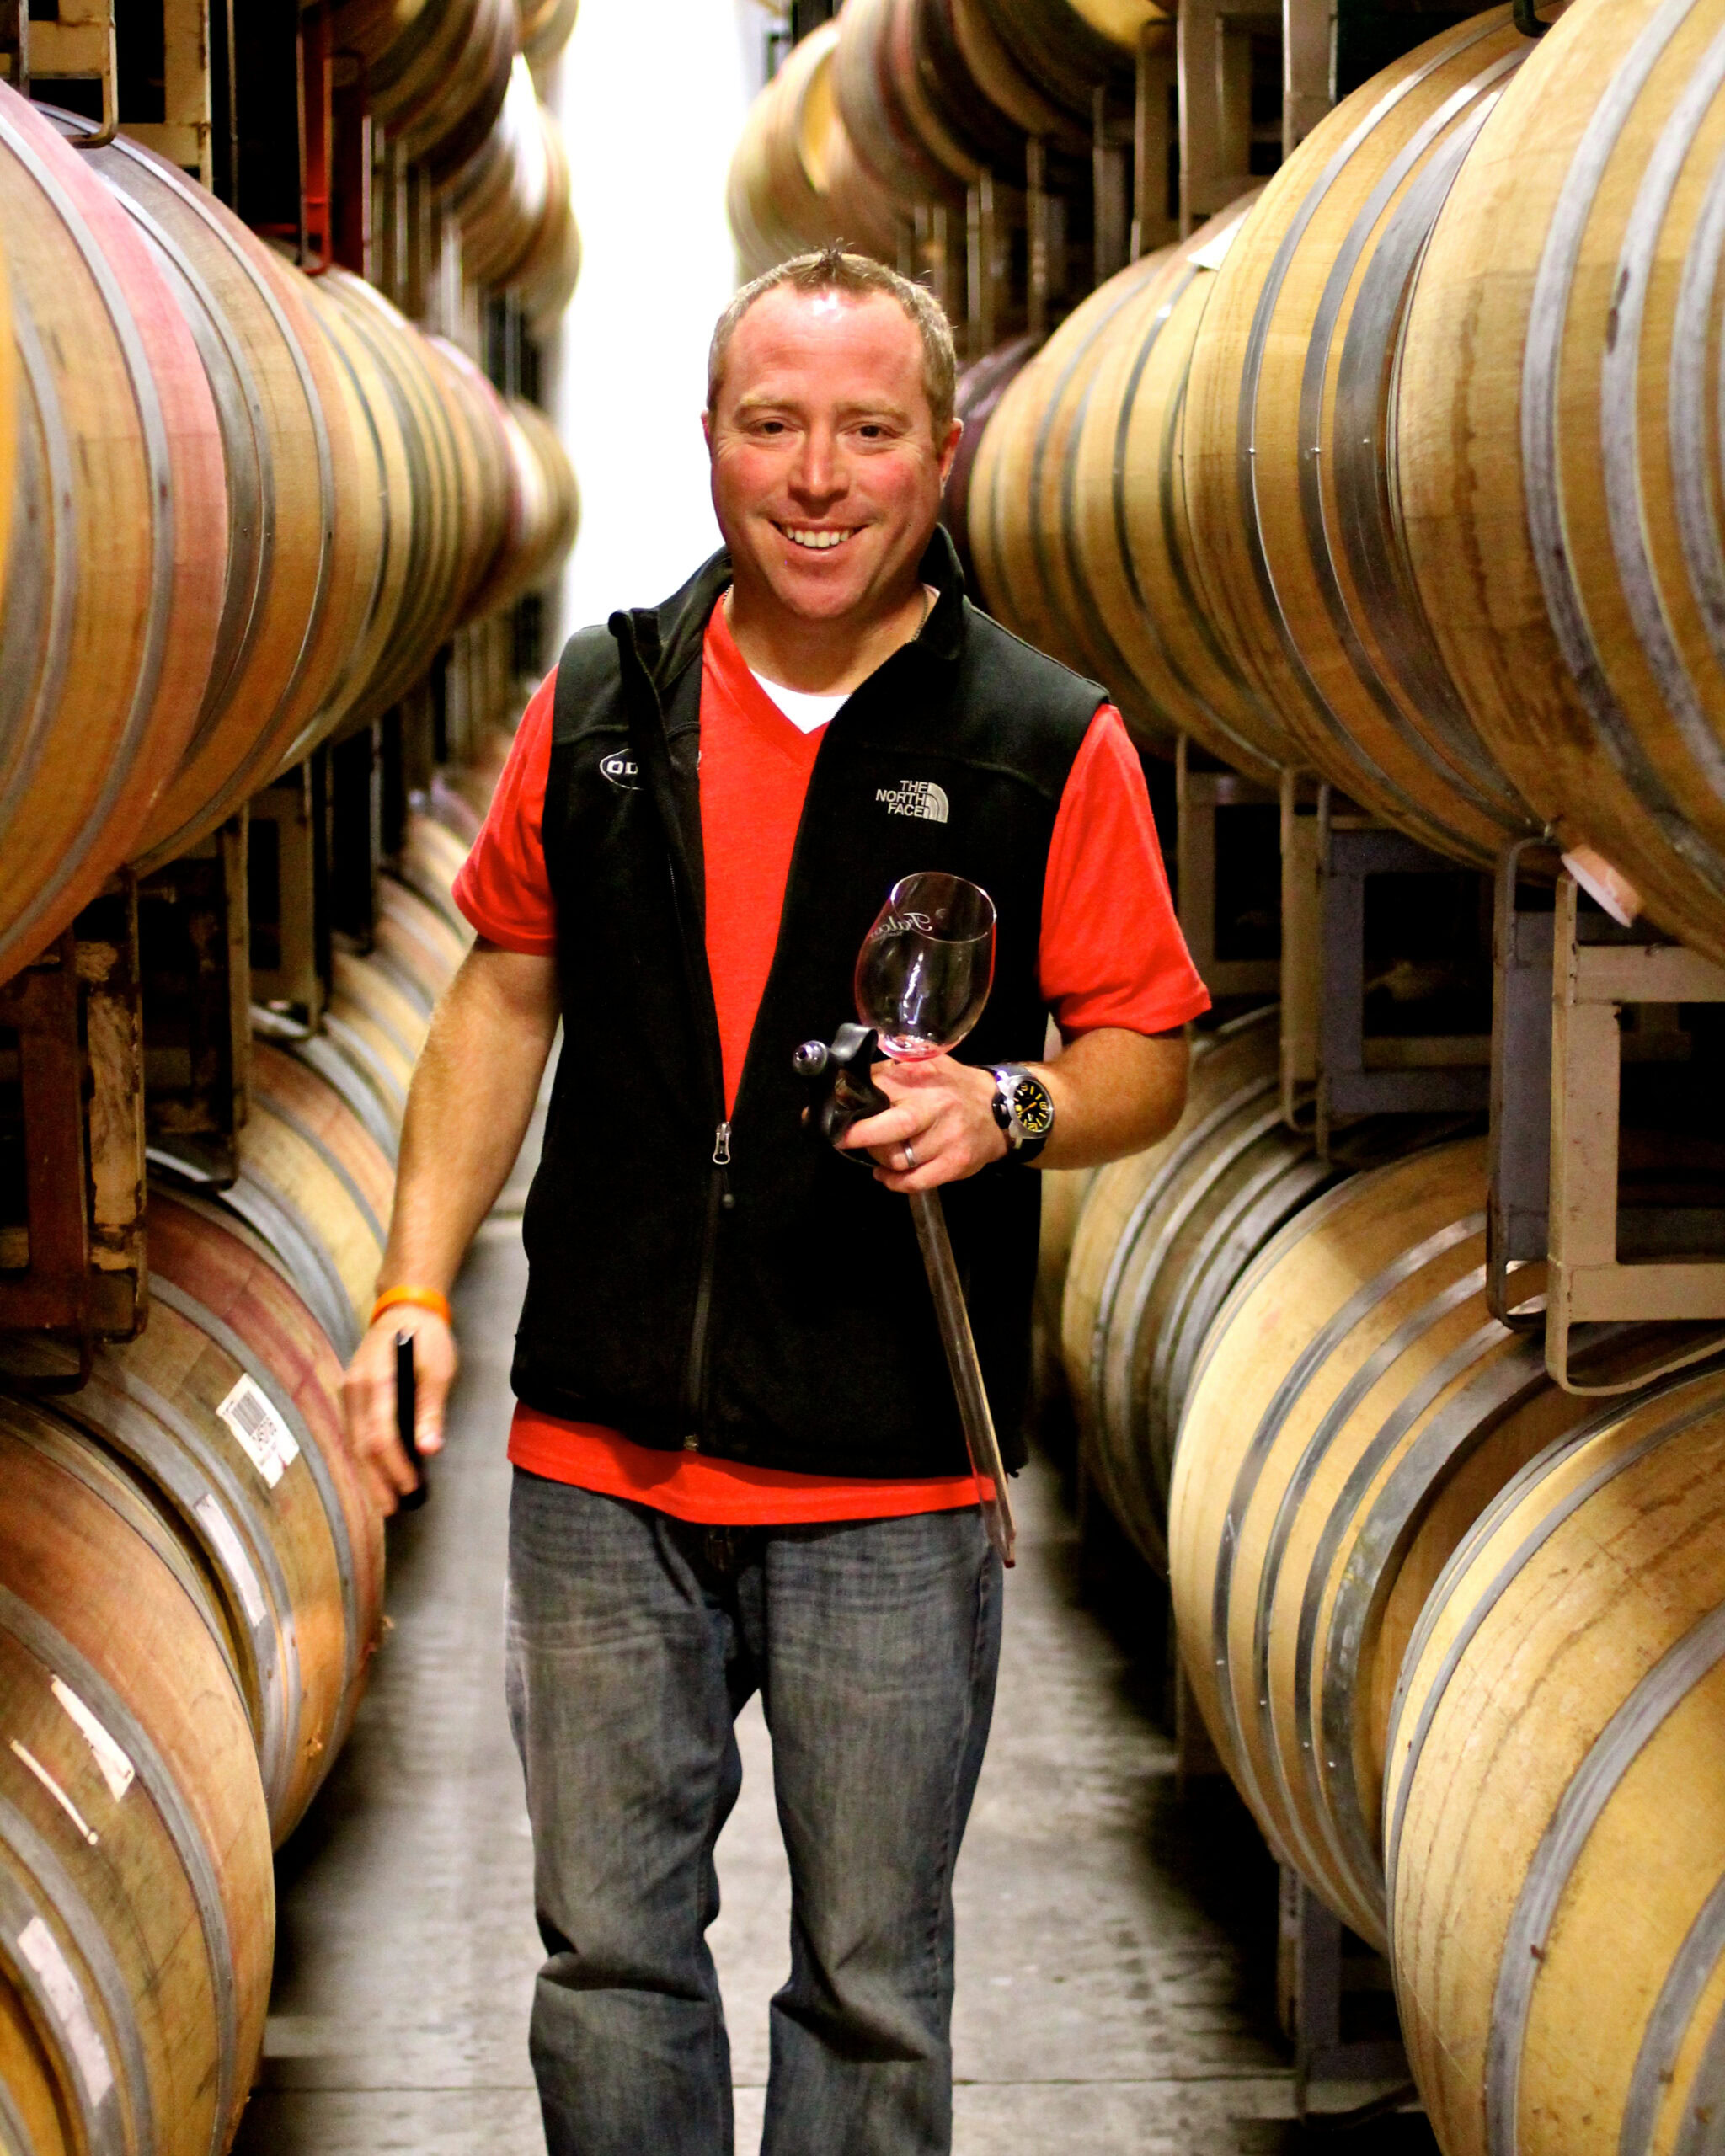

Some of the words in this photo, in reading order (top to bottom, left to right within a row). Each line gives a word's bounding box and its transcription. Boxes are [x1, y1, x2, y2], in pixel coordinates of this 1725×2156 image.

[900, 780, 928, 793] THE
[875, 788, 926, 806] NORTH
[887, 803, 924, 818] FACE
